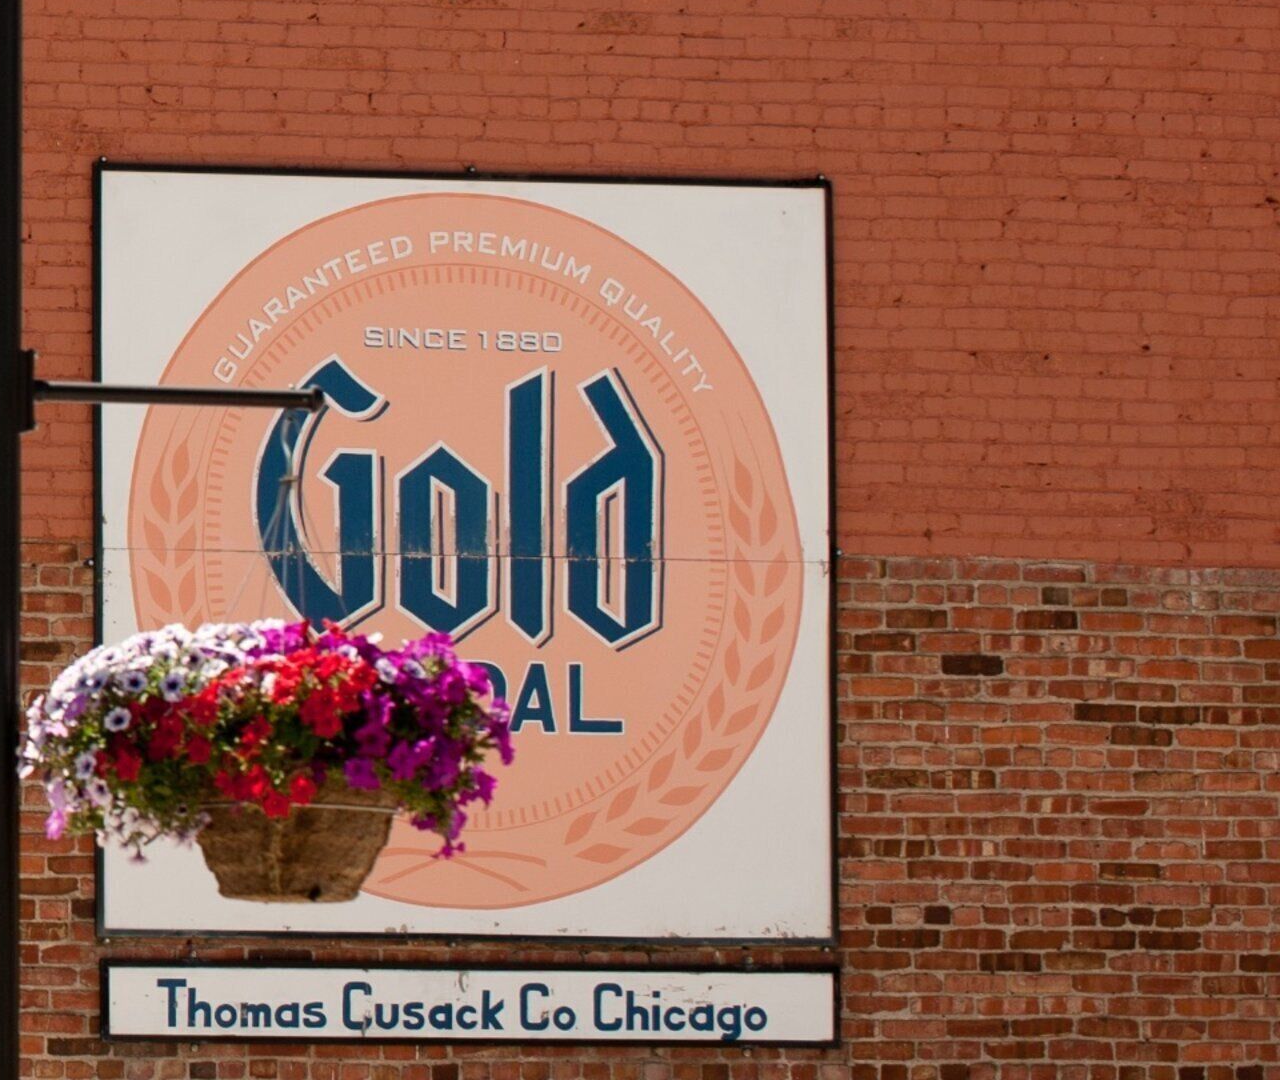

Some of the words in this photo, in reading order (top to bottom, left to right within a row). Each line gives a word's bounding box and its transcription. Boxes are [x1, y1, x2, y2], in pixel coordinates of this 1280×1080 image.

[212, 234, 414, 384] GUARANTEED
[428, 230, 592, 286] PREMIUM
[599, 276, 714, 396] QUALITY
[364, 325, 468, 351] SINCE
[477, 330, 563, 353] 1880
[251, 353, 666, 655] Gold
[156, 977, 328, 1029] Thomas
[342, 981, 505, 1031] Cusack
[519, 982, 577, 1032] Co
[593, 982, 768, 1041] Chicago
